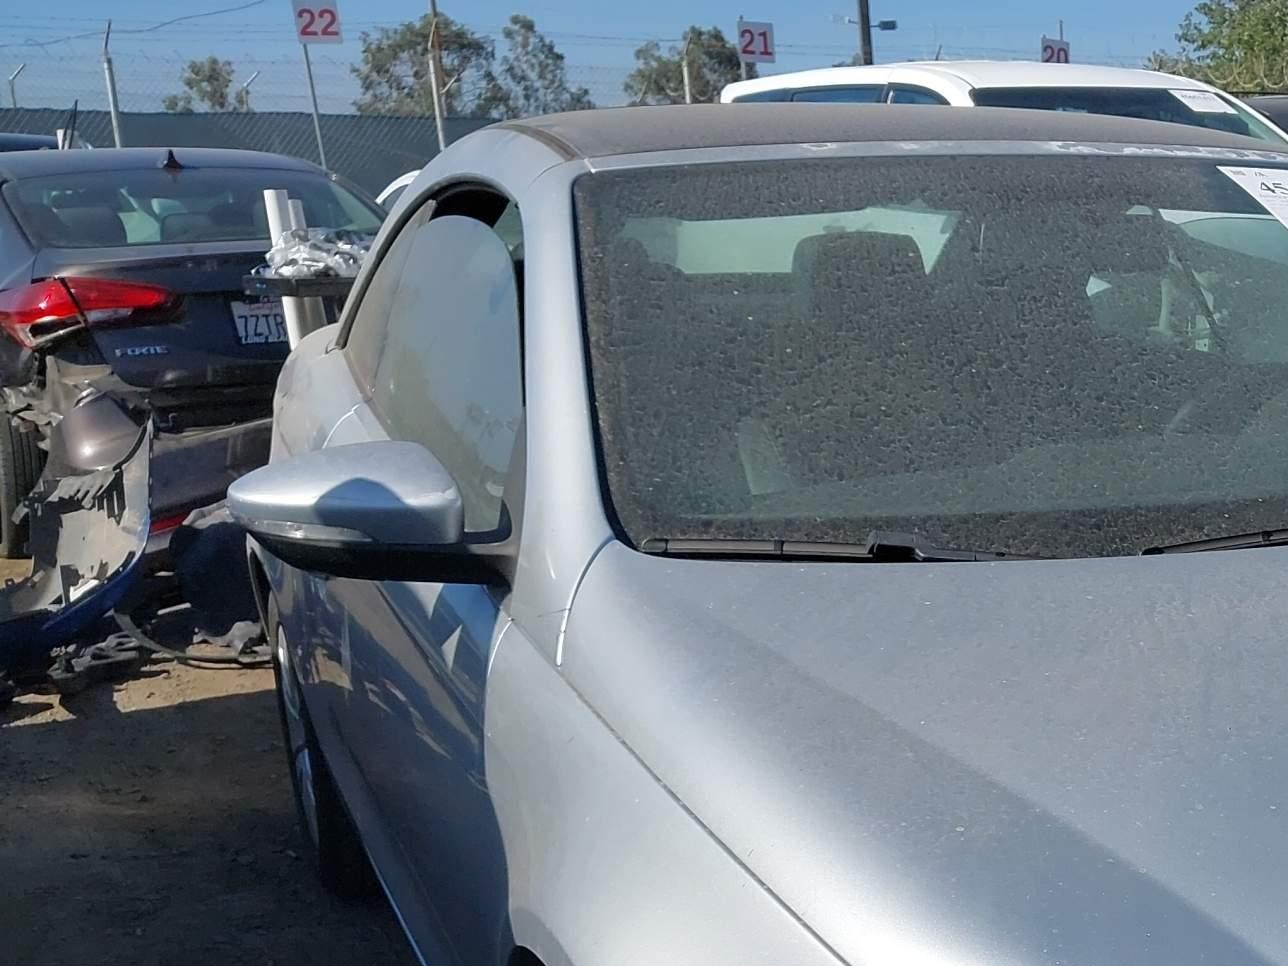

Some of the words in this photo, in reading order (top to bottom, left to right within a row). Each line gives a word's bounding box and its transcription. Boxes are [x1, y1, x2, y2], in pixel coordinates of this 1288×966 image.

[297, 8, 339, 36] 22
[740, 29, 773, 56] 21
[1043, 45, 1068, 63] 20
